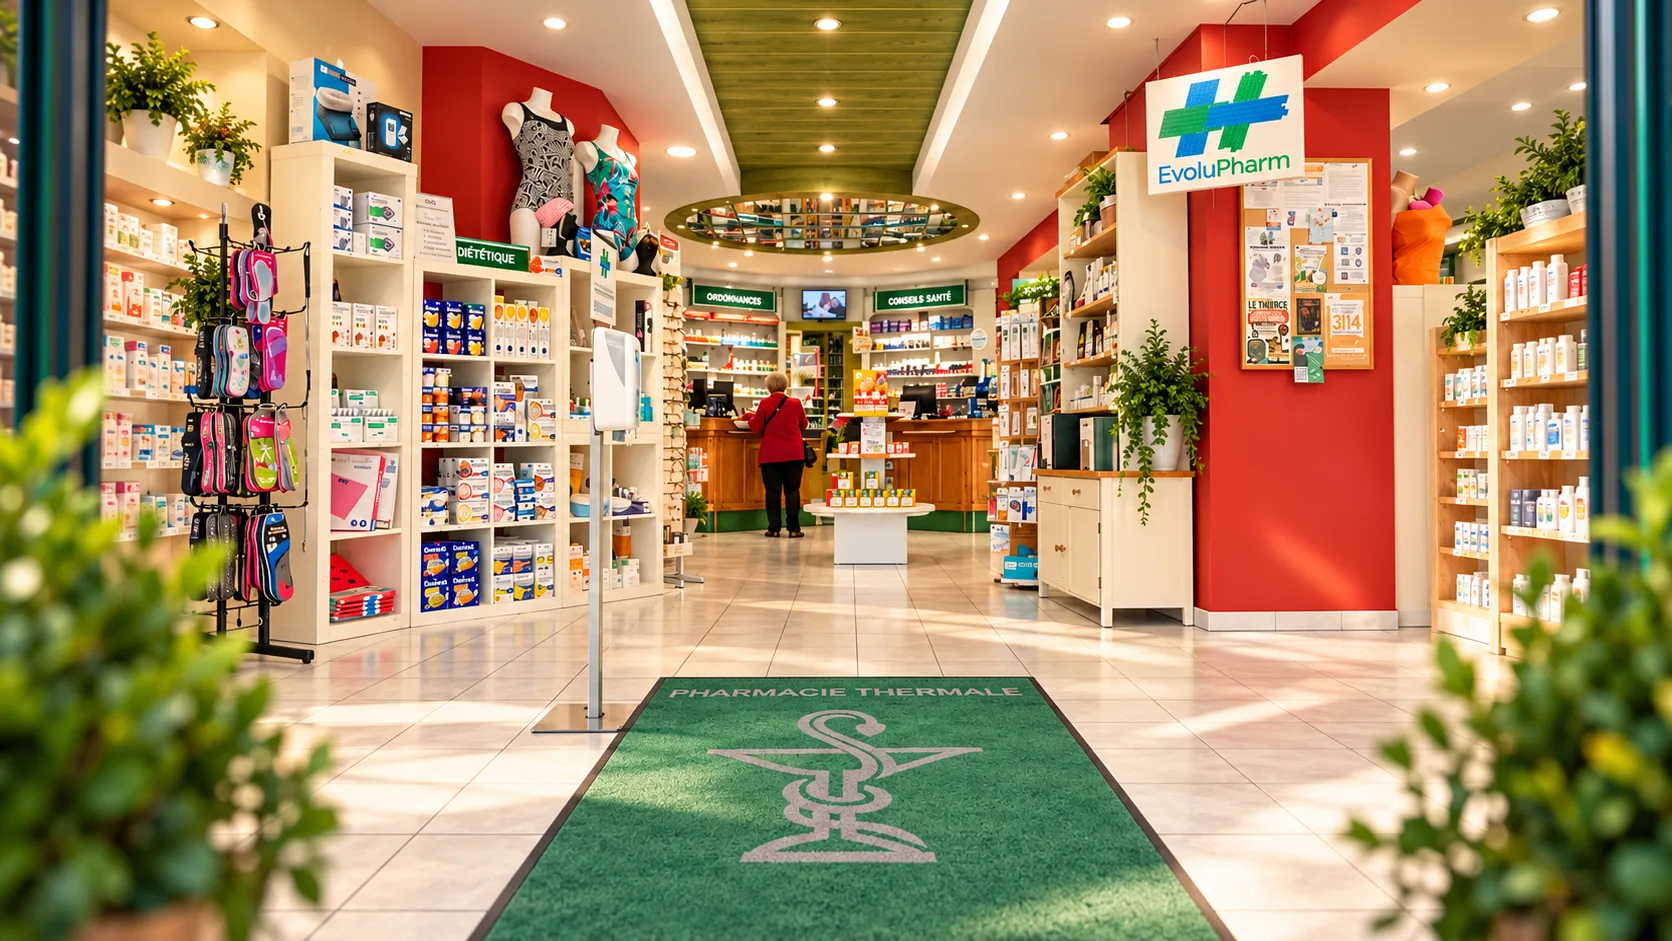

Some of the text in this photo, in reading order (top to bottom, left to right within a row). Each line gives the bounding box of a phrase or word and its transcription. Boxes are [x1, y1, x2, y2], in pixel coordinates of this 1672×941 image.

[1159, 154, 1290, 184] EvoluPharm
[457, 246, 515, 264] DIÉTÉTIQUE
[888, 290, 952, 306] CONSEILS SANTÉ
[1332, 314, 1361, 330] 3114
[668, 687, 1023, 698] PHARMACIE THERMALE
